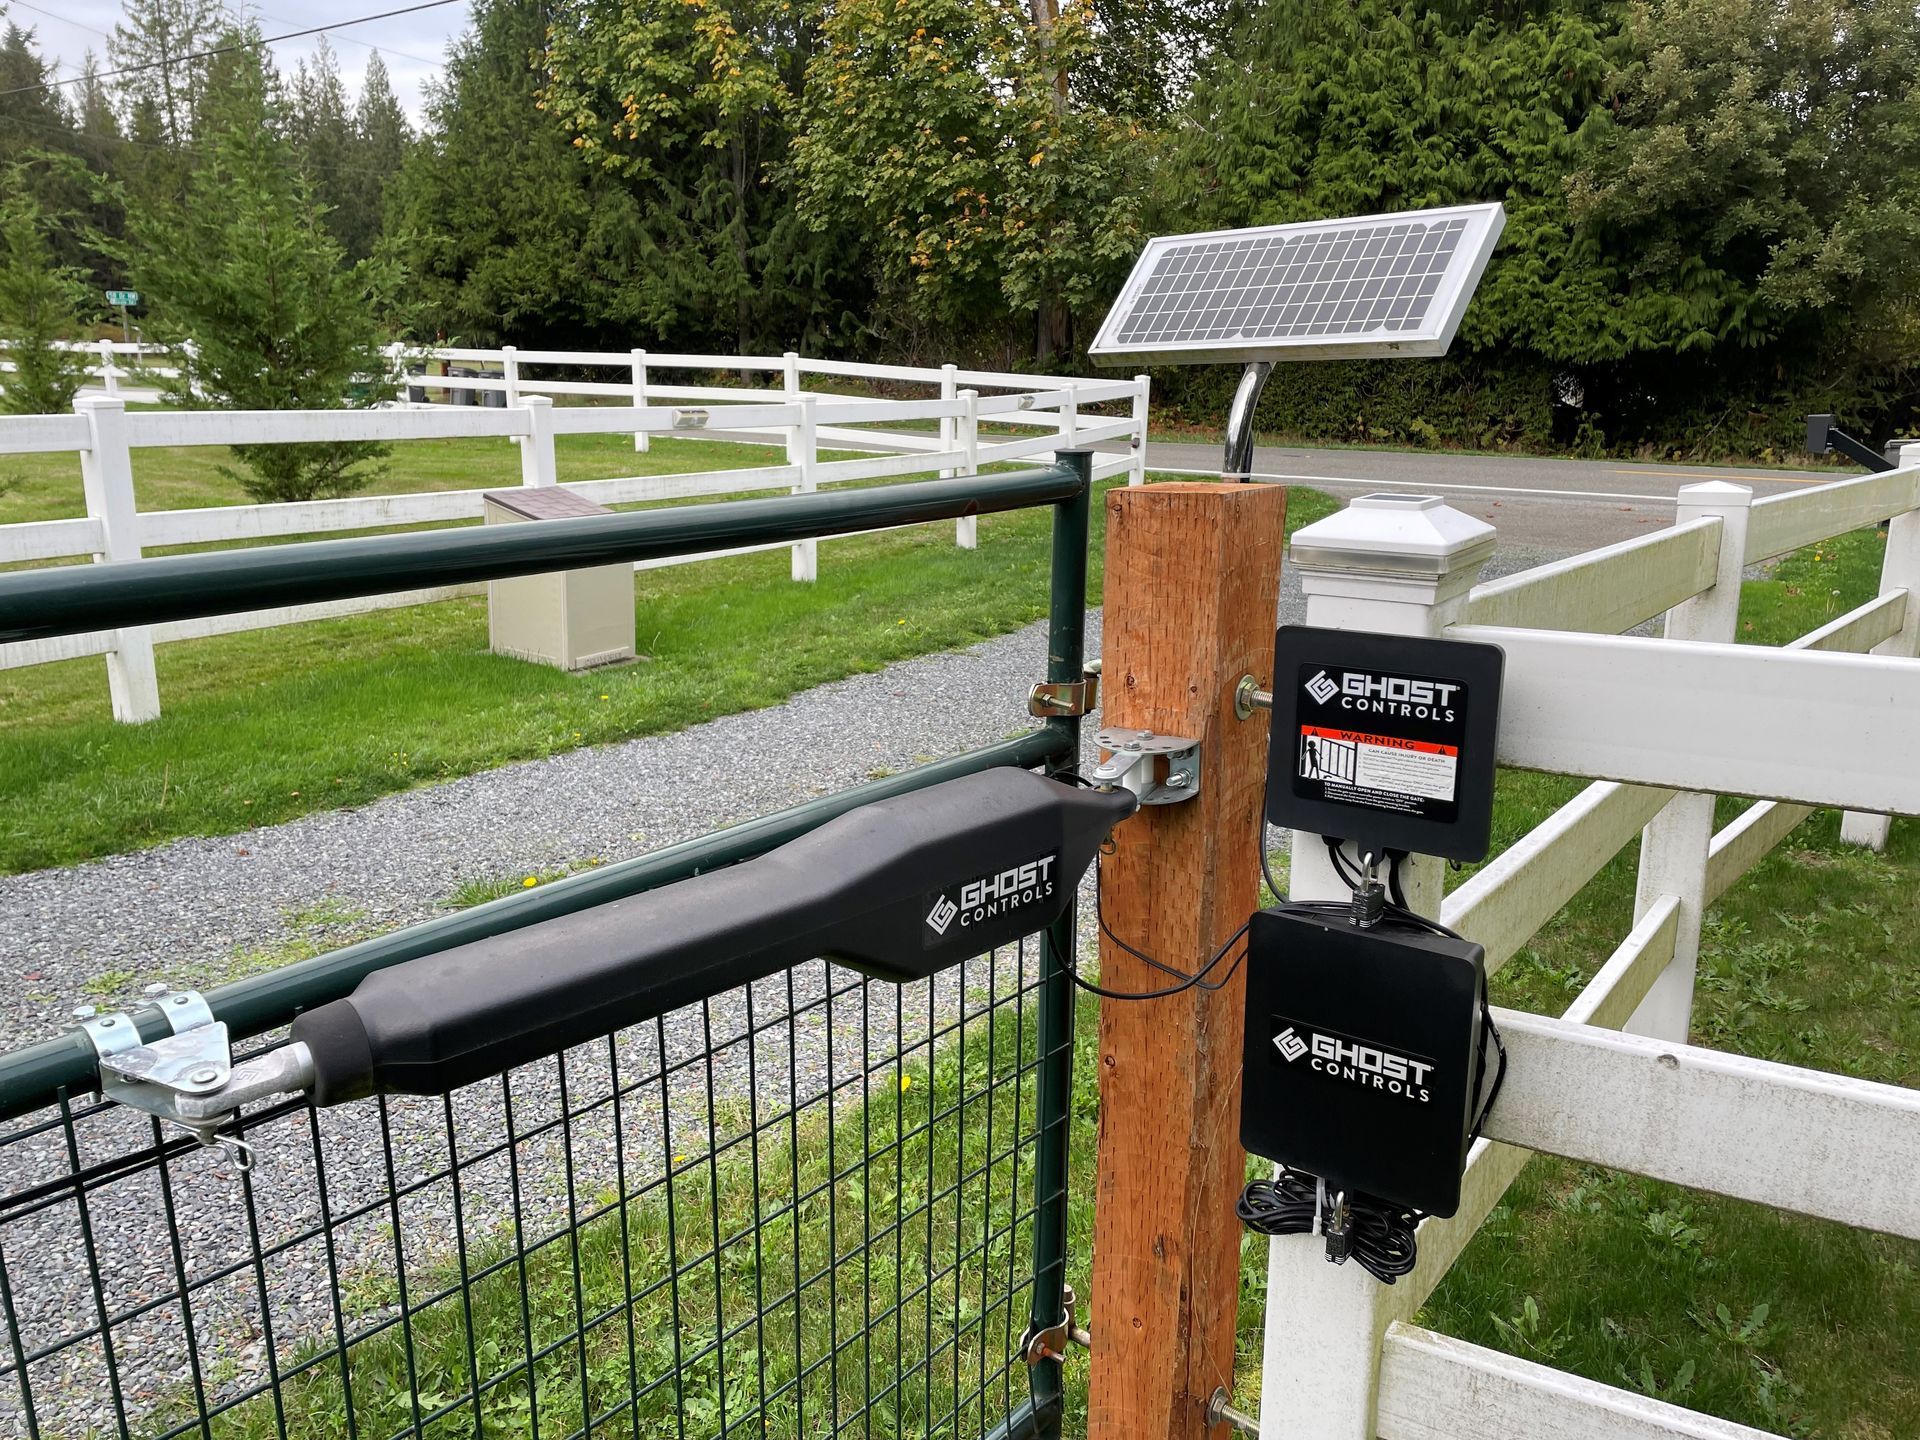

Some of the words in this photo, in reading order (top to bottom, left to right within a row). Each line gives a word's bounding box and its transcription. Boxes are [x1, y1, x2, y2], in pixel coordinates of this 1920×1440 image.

[1342, 672, 1457, 707] GHOST
[1341, 697, 1455, 722] CONTROLS
[1340, 731, 1415, 750] WARNING
[1398, 752, 1417, 760] INJURY
[1331, 782, 1357, 791] MANUALLY
[1357, 786, 1371, 794] OPEN
[1383, 791, 1399, 799] CLOSE
[961, 855, 1054, 911] GHOST
[960, 882, 1053, 926] CONTROLS
[1311, 1033, 1431, 1085] GHOST
[1311, 1058, 1430, 1102] CONTROLS
